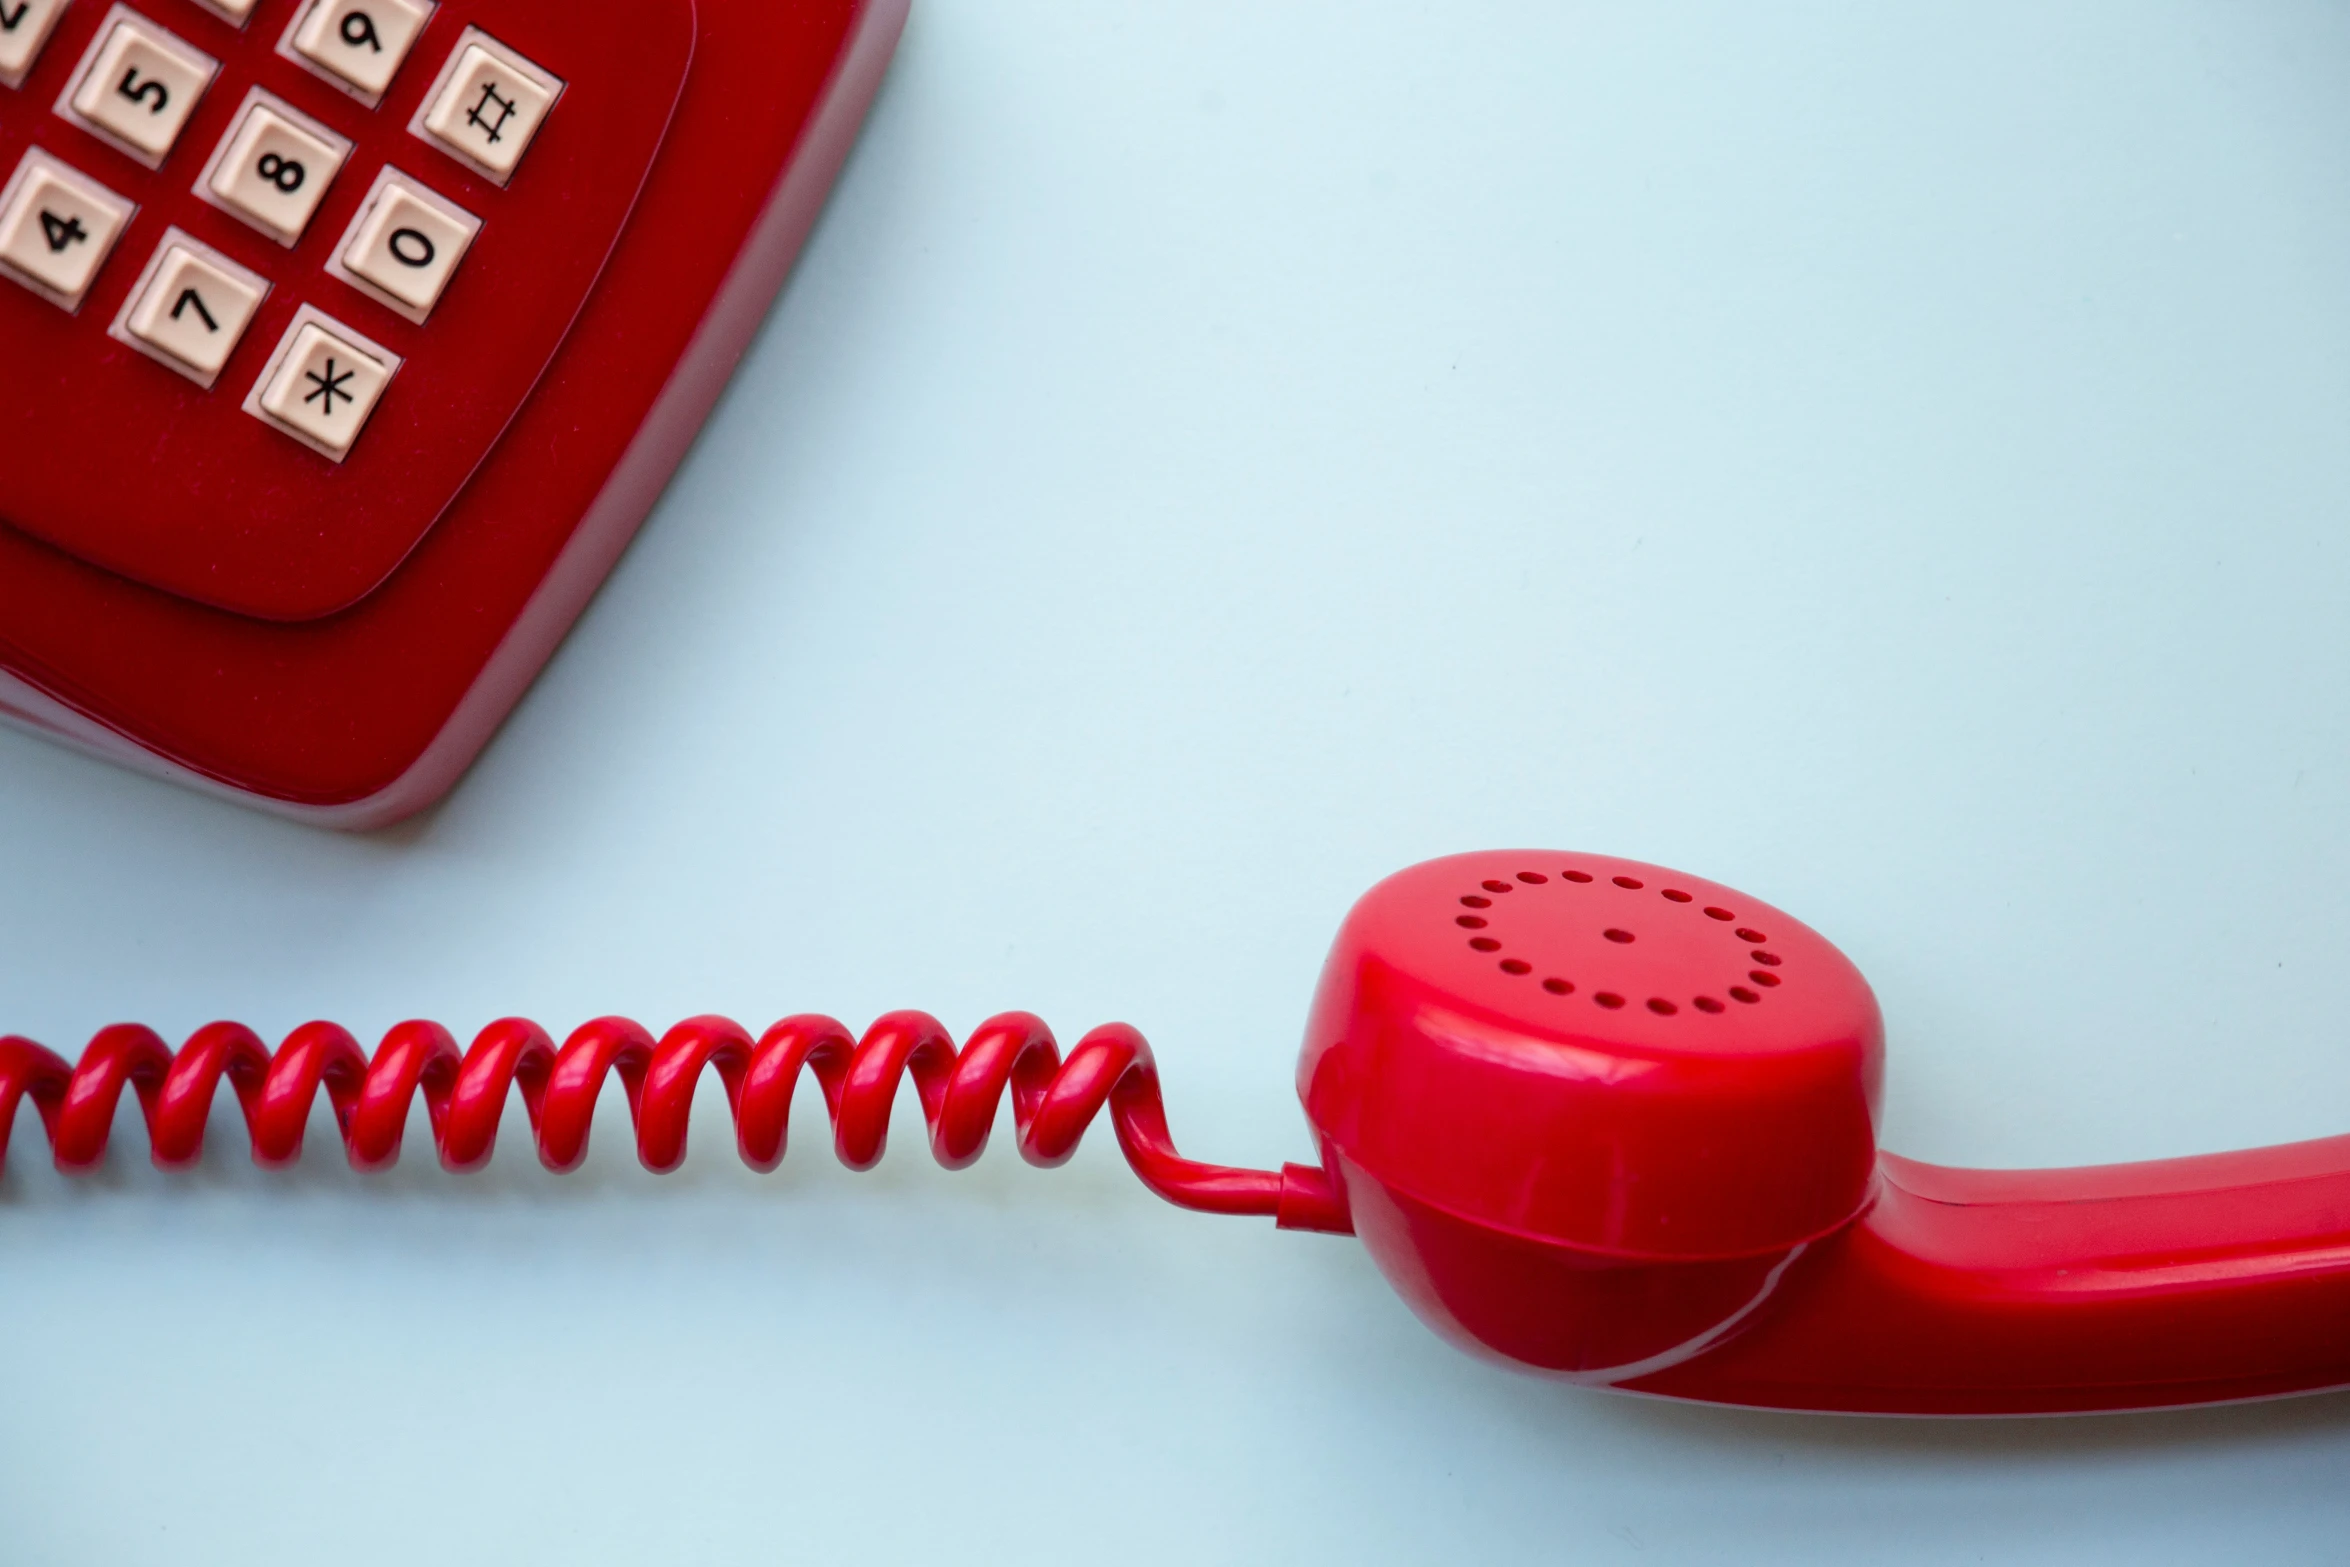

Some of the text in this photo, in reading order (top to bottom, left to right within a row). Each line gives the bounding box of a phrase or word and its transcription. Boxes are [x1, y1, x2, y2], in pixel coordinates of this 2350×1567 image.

[339, 10, 382, 53] 9
[117, 66, 169, 113] 5
[466, 82, 516, 143] #
[256, 152, 305, 193] 8
[39, 209, 88, 252] 4
[388, 227, 435, 268] 0
[170, 288, 219, 332] 7
